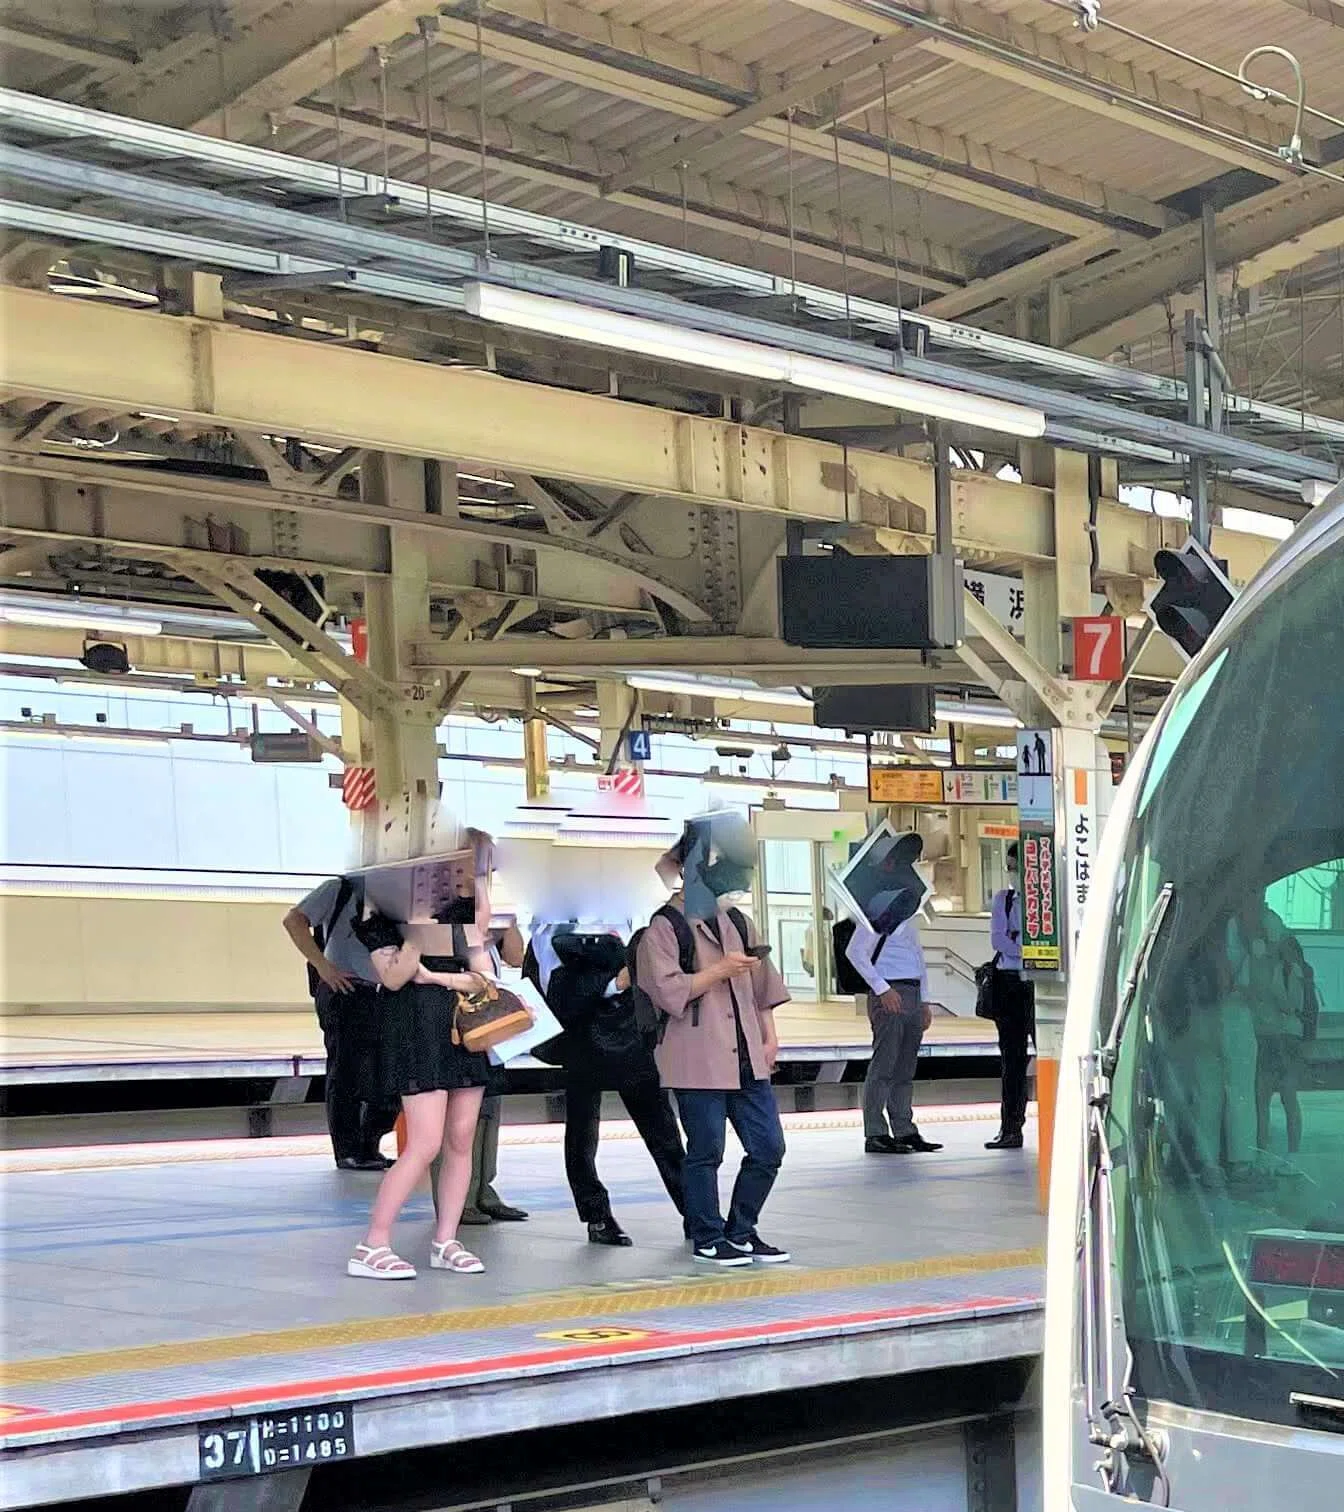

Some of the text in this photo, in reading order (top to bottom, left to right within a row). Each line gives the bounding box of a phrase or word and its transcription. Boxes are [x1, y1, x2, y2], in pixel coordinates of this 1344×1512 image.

[1083, 623, 1113, 675] 7
[633, 732, 648, 758] 4
[203, 1430, 248, 1469] 37
